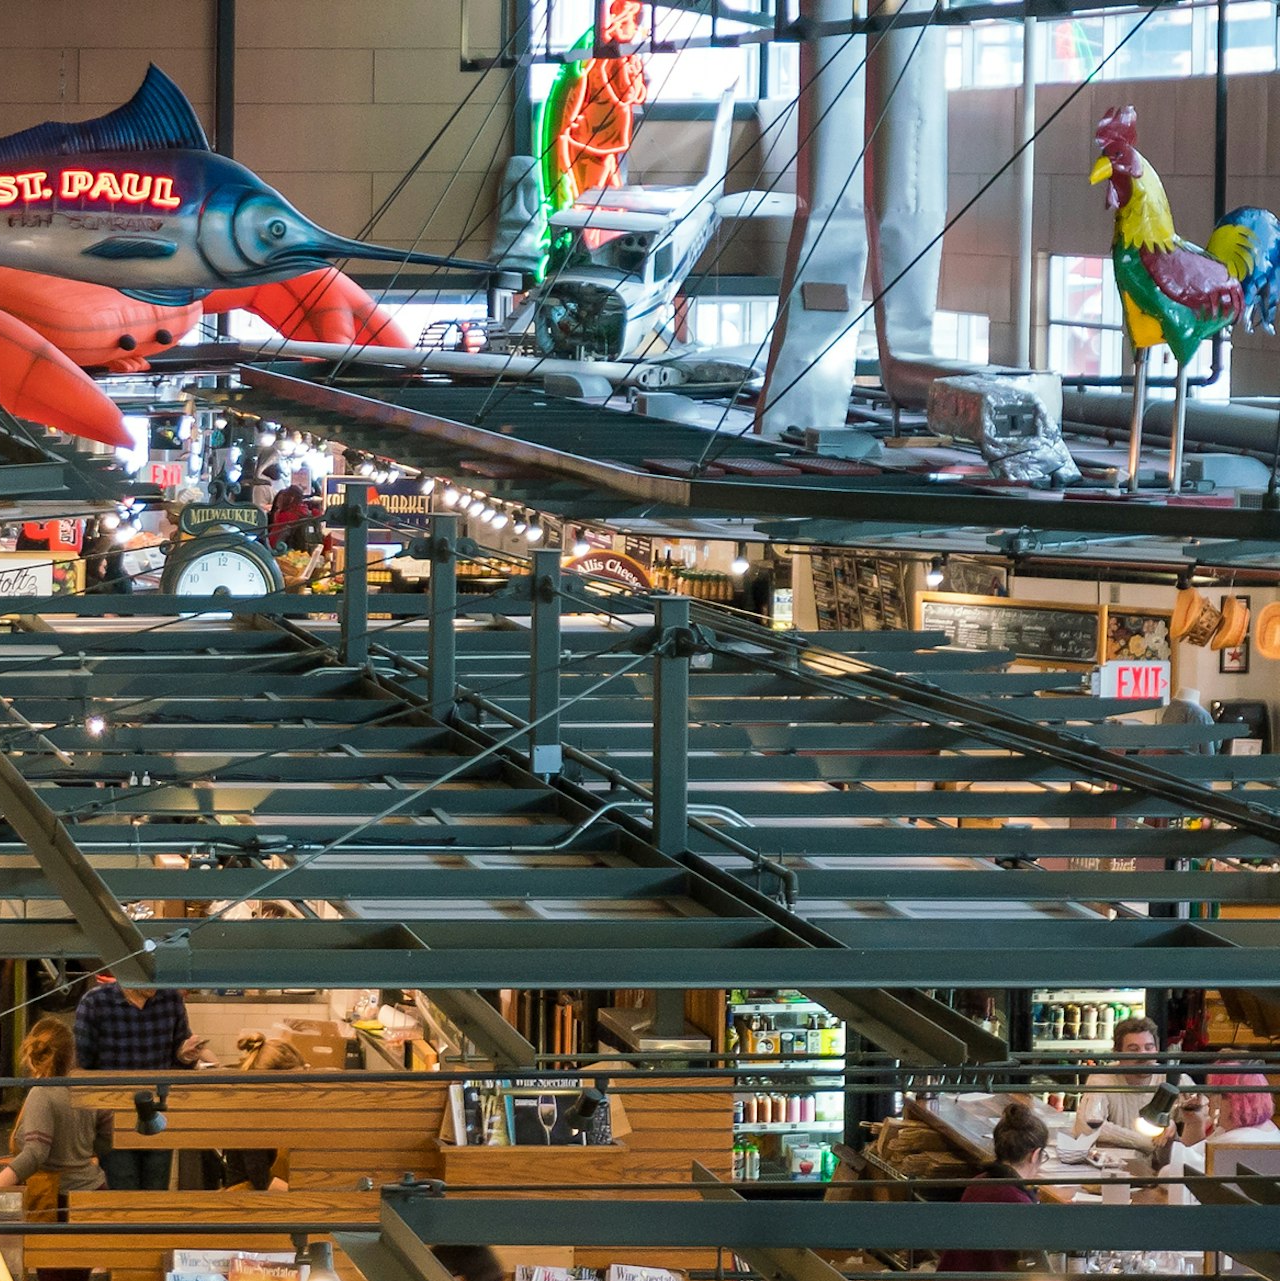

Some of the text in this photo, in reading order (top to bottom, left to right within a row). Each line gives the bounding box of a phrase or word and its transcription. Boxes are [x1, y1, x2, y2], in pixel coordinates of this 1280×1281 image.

[61, 170, 181, 208] PAUL
[8, 213, 163, 232] FISH COMPANY
[151, 464, 182, 489] EXIT
[190, 508, 258, 526] MILWAUKEE
[218, 557, 228, 566] 12
[576, 558, 642, 590] Allis Cheese
[1117, 666, 1162, 698] EXIT
[537, 1078, 579, 1088] Spectator
[255, 1261, 299, 1278] Spectator
